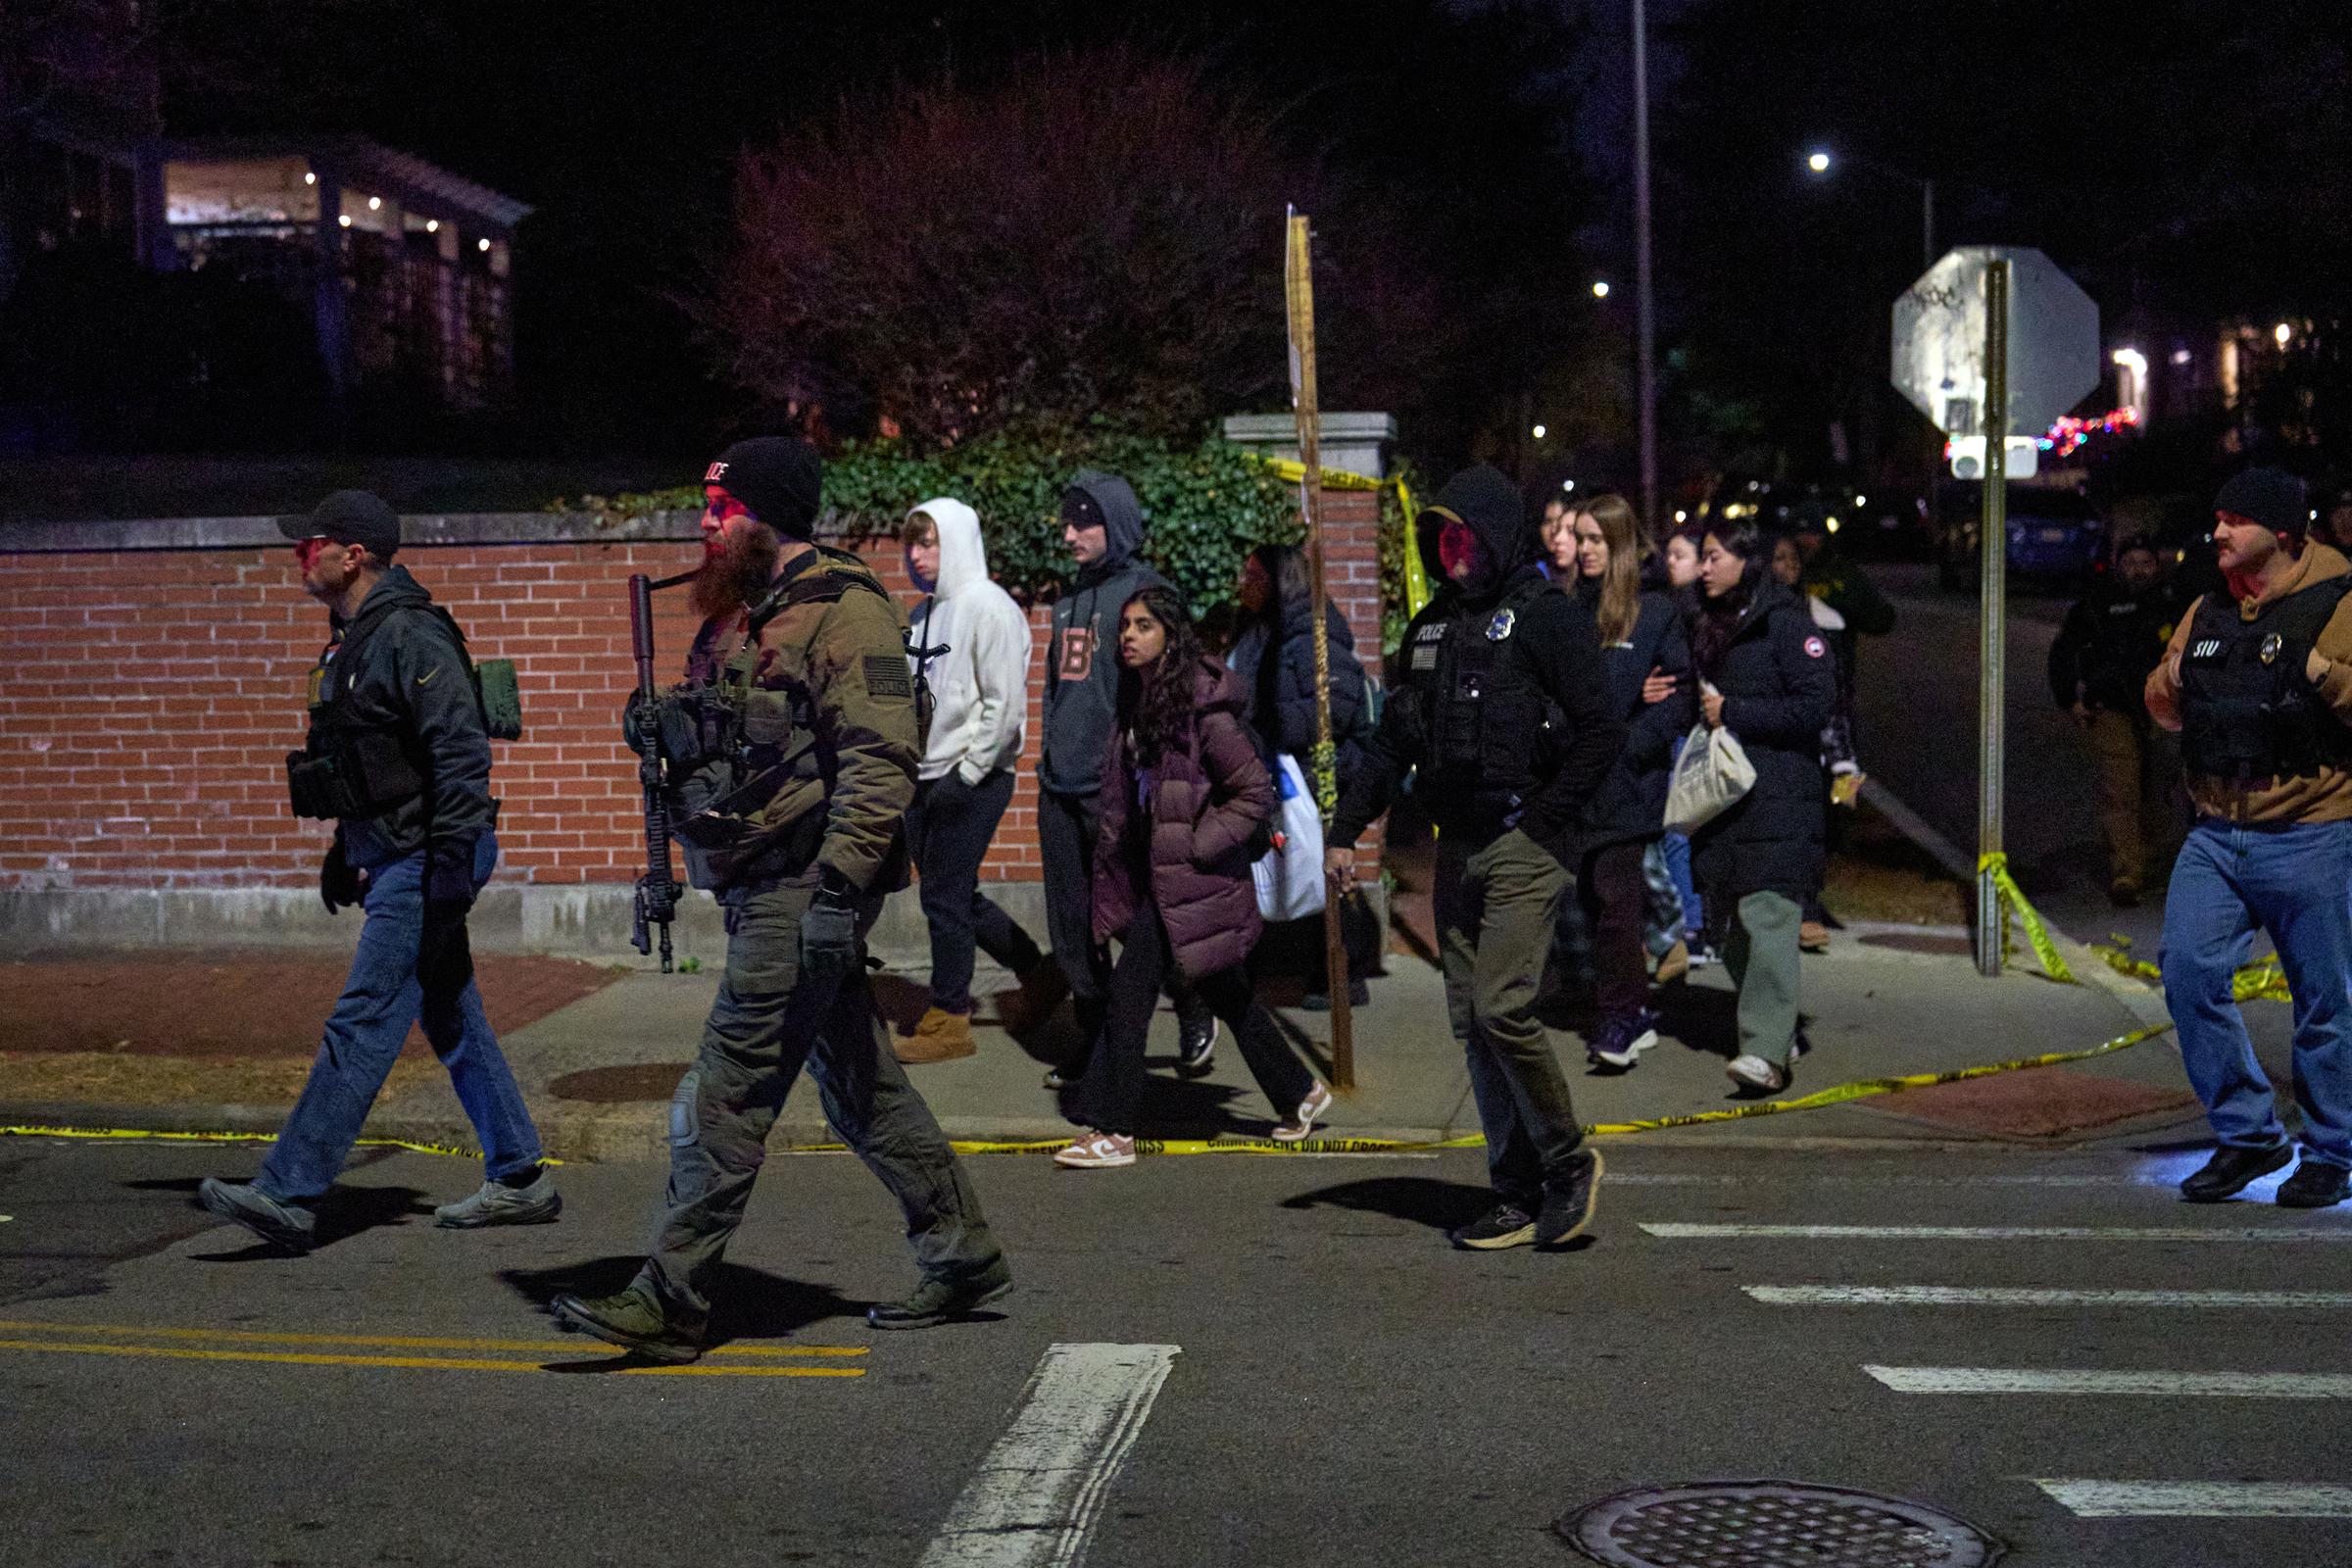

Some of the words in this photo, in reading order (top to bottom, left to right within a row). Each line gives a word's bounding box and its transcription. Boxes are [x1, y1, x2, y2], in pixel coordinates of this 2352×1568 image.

[1059, 627, 1093, 681] B
[2192, 640, 2221, 658] SIU
[870, 681, 909, 694] POLICE
[1301, 1140, 1319, 1152] DO
[1322, 1140, 1348, 1152] NOT
